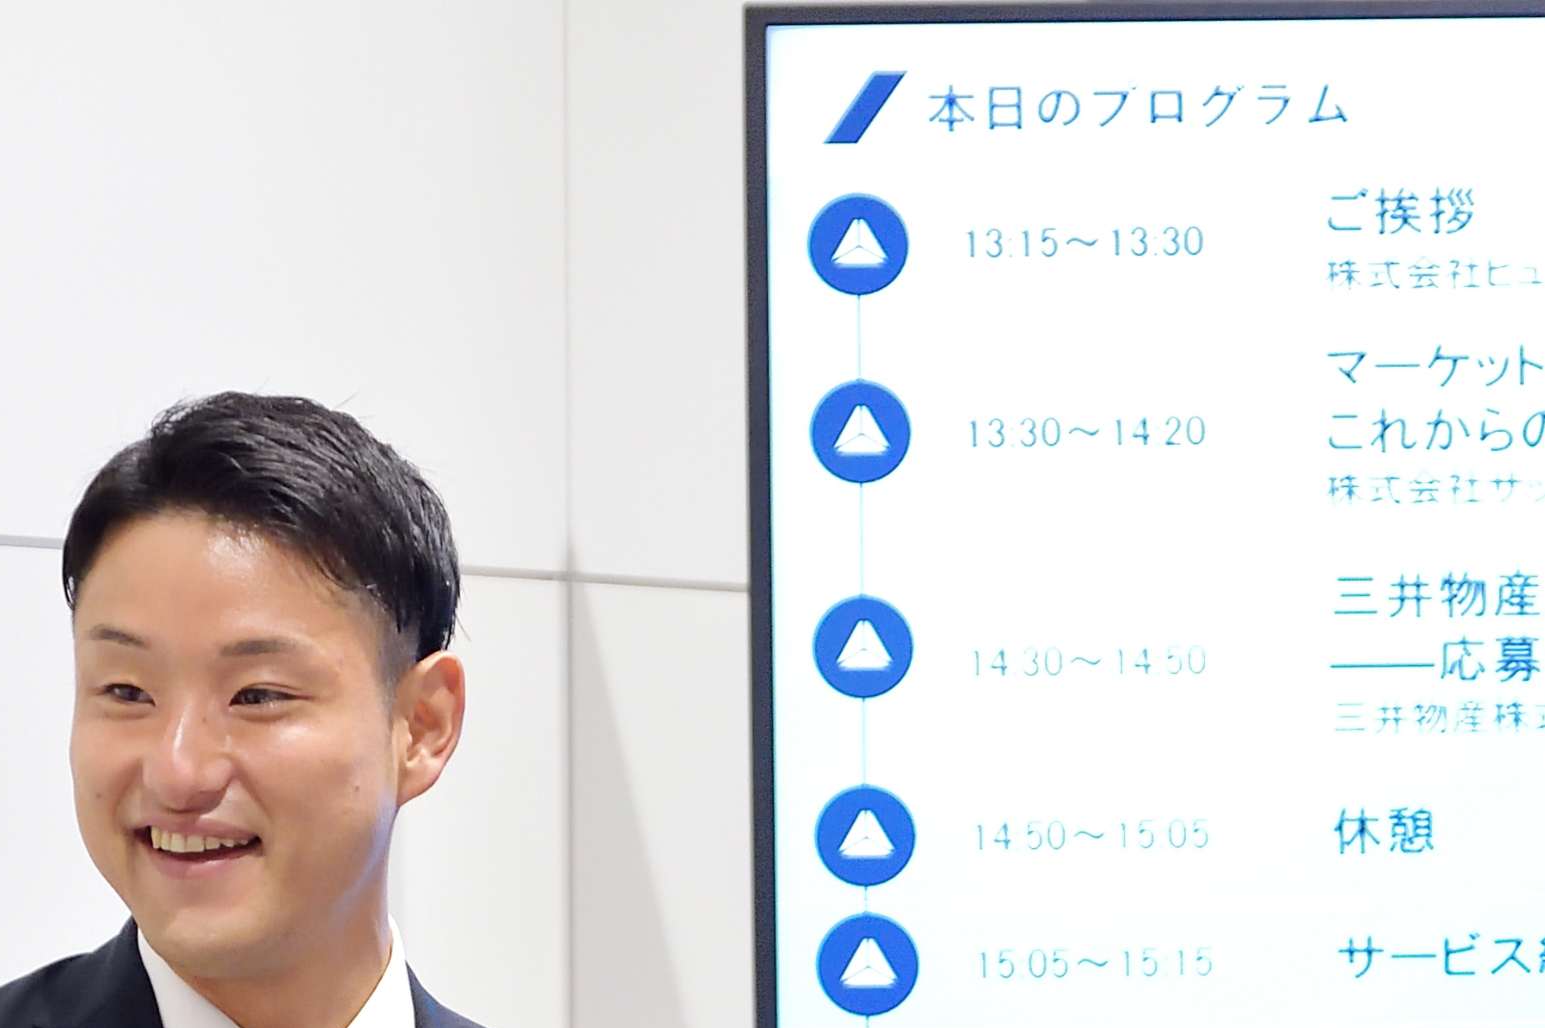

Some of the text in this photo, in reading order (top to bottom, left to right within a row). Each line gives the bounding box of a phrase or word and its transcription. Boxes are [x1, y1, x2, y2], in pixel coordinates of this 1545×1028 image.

[1327, 186, 1475, 235] ご挨拶
[1326, 344, 1544, 388] マーケット
[1333, 569, 1541, 618] 三井物産
[1335, 700, 1545, 733] 三井物産株
[1332, 806, 1435, 856] 休憩
[1337, 931, 1545, 979] サービス
